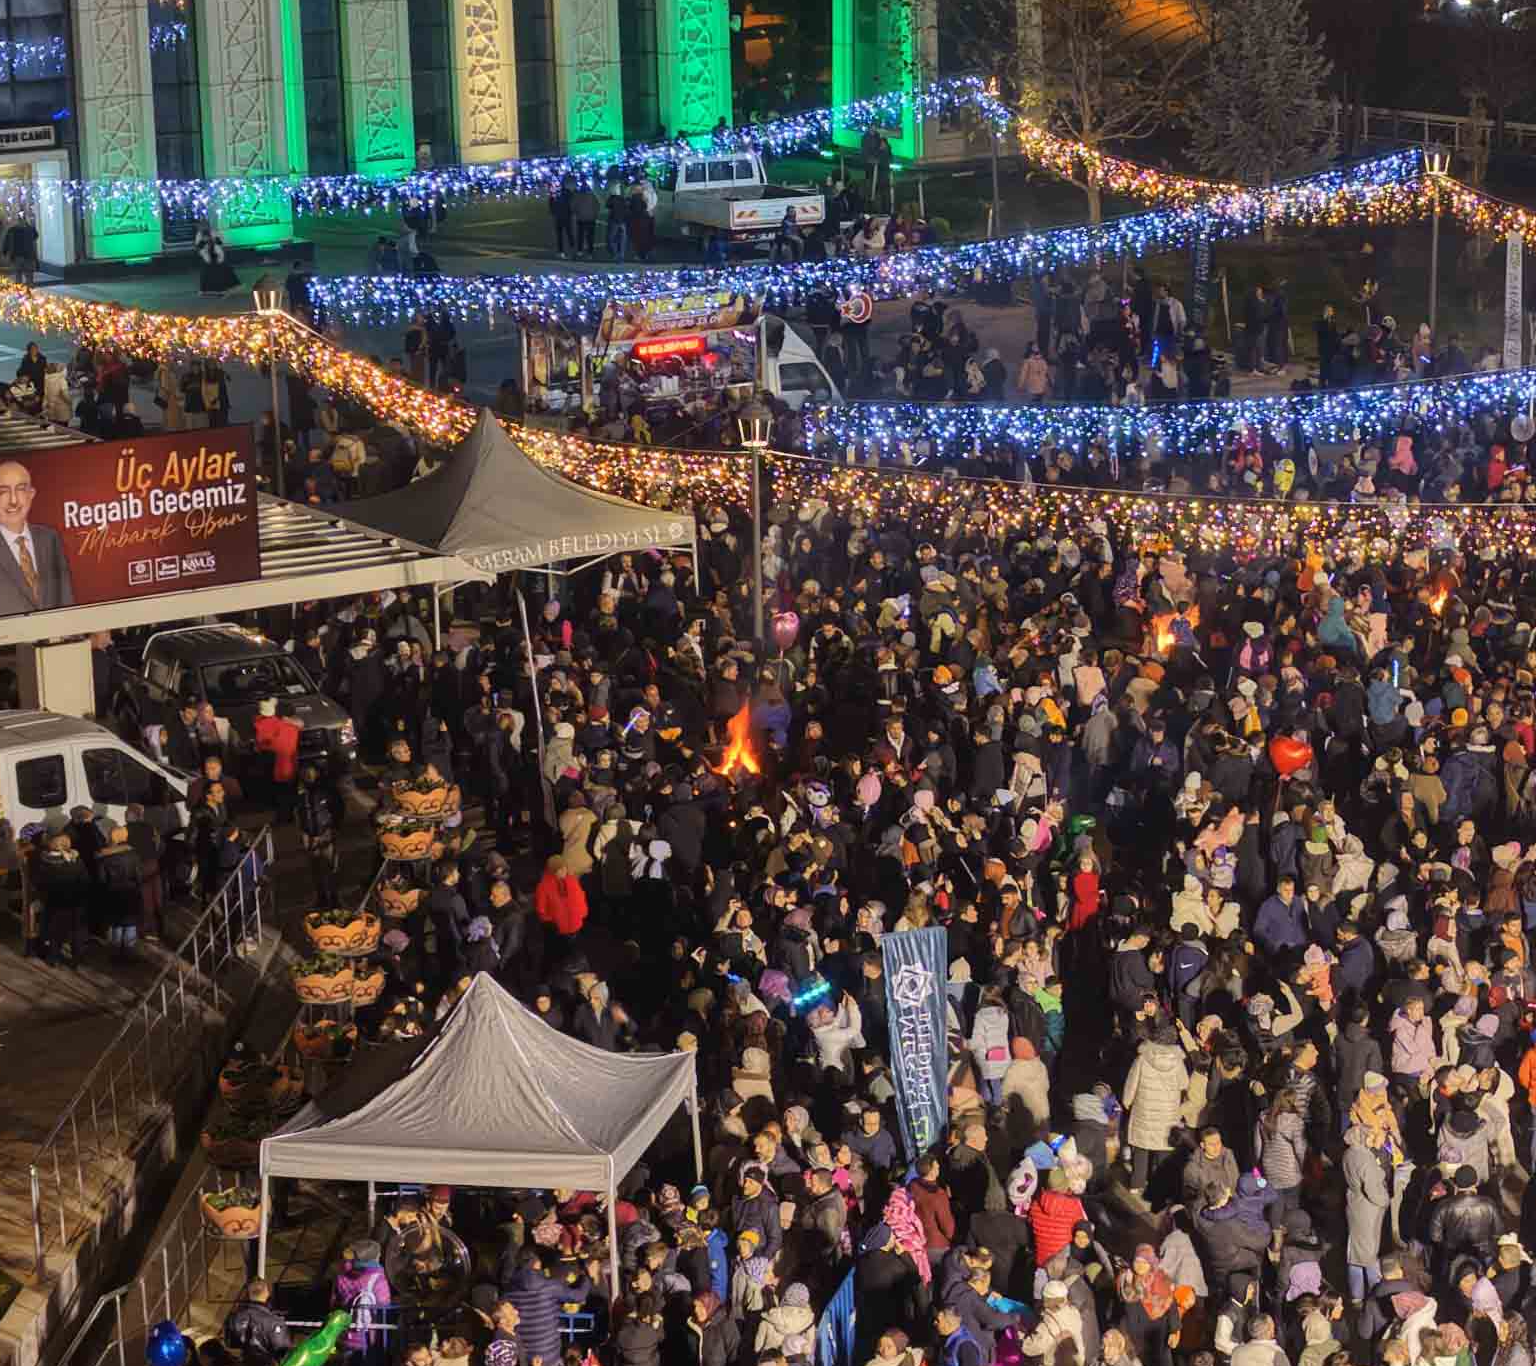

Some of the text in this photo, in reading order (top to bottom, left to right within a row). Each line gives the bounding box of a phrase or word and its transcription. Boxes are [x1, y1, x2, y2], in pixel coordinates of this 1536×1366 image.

[116, 447, 245, 498] Üç Aylar ve
[64, 478, 247, 531] Regaib Gecemiz
